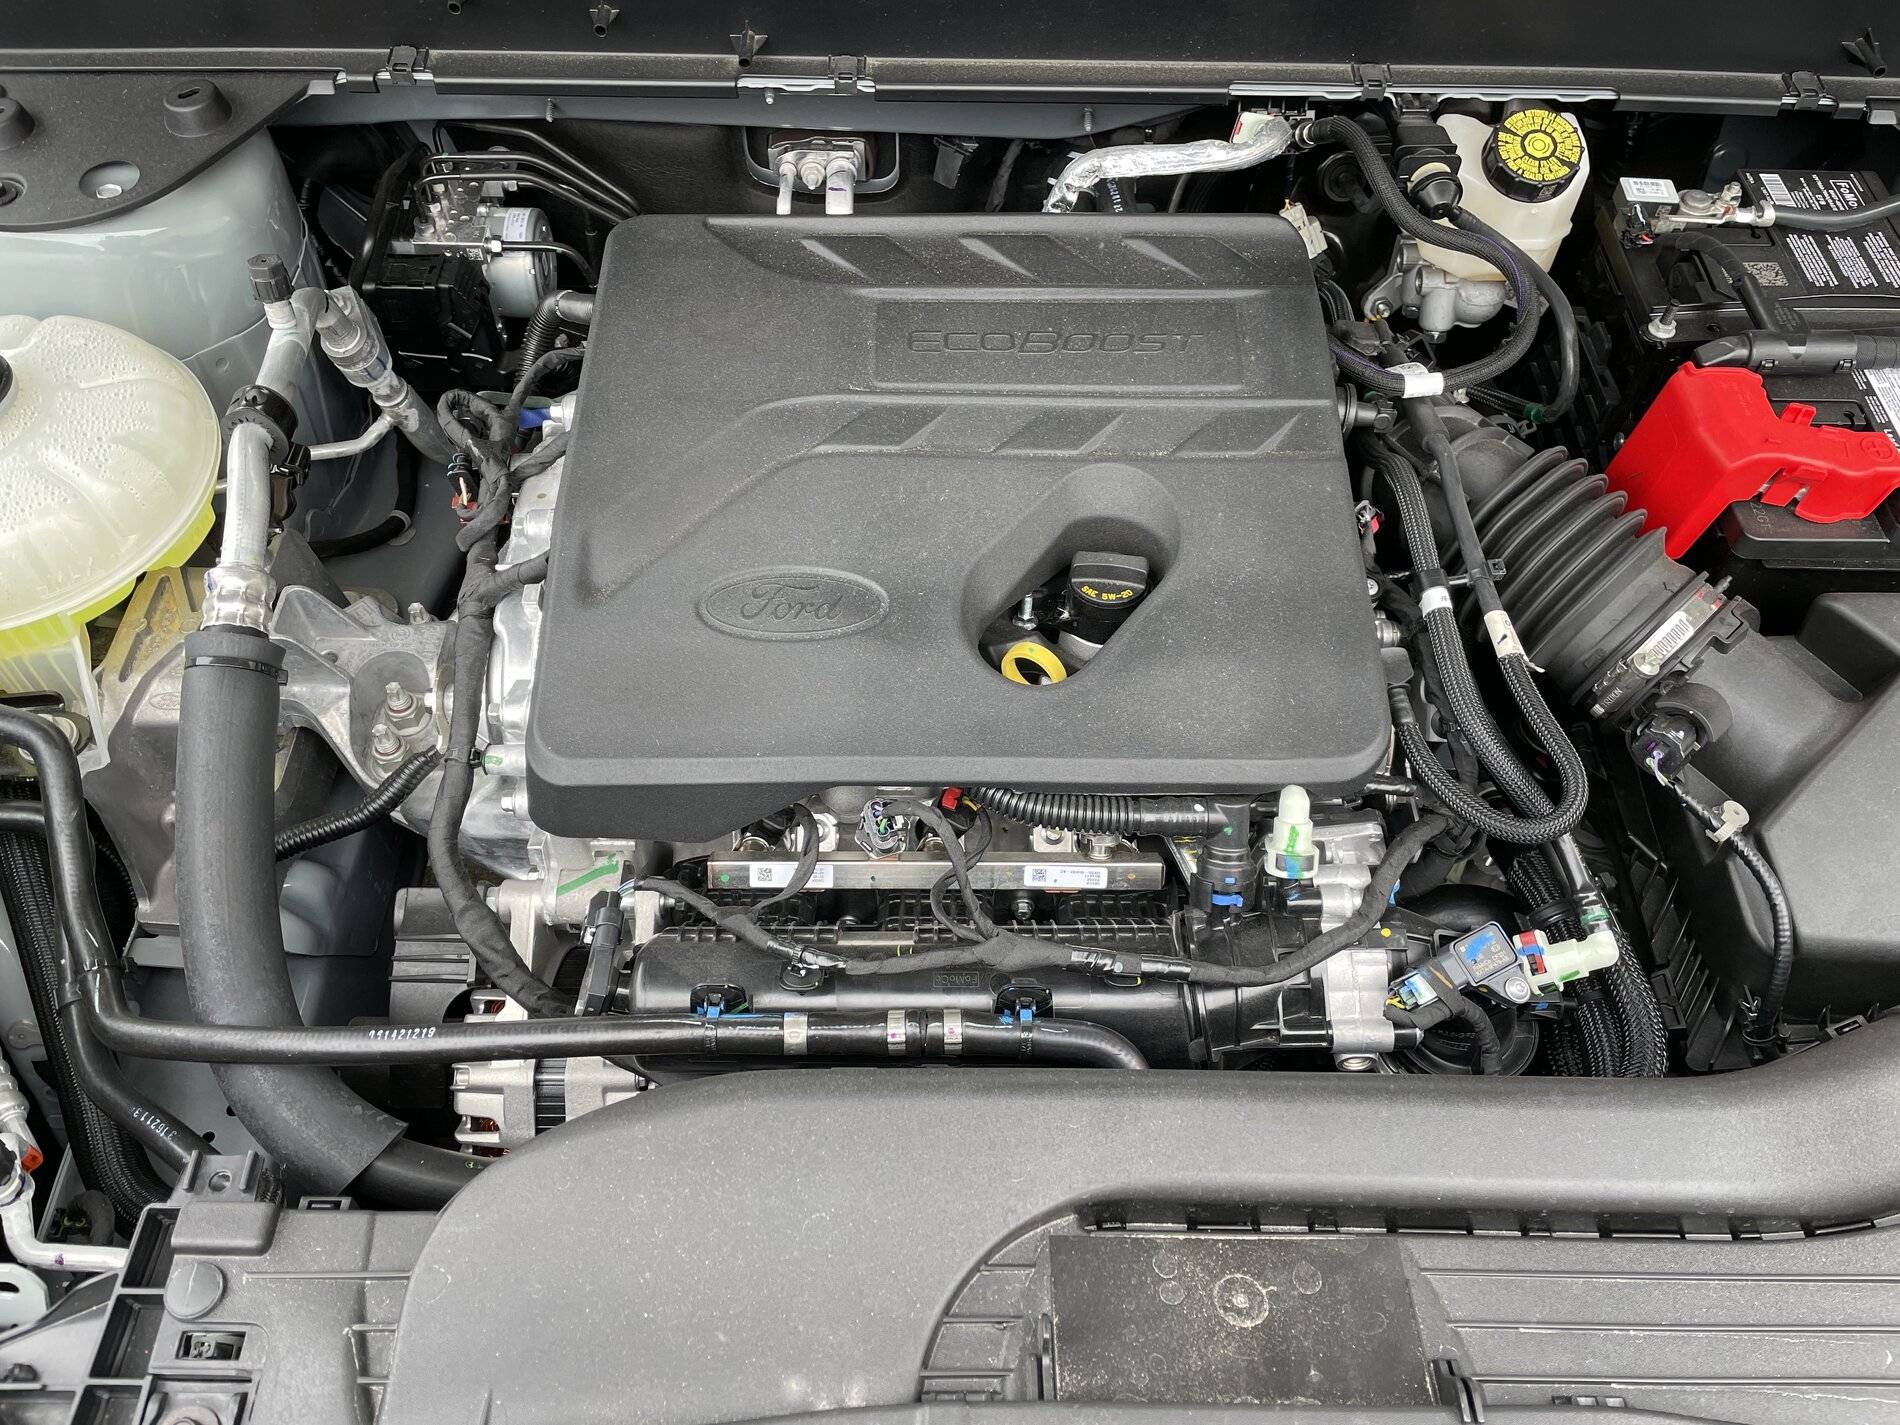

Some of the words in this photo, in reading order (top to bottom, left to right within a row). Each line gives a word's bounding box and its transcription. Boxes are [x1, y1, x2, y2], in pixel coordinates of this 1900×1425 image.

[909, 330, 1203, 354] ECOBOOST
[740, 583, 843, 622] Ford
[1081, 585, 1099, 598] SAE
[1101, 589, 1133, 600] 5W-20
